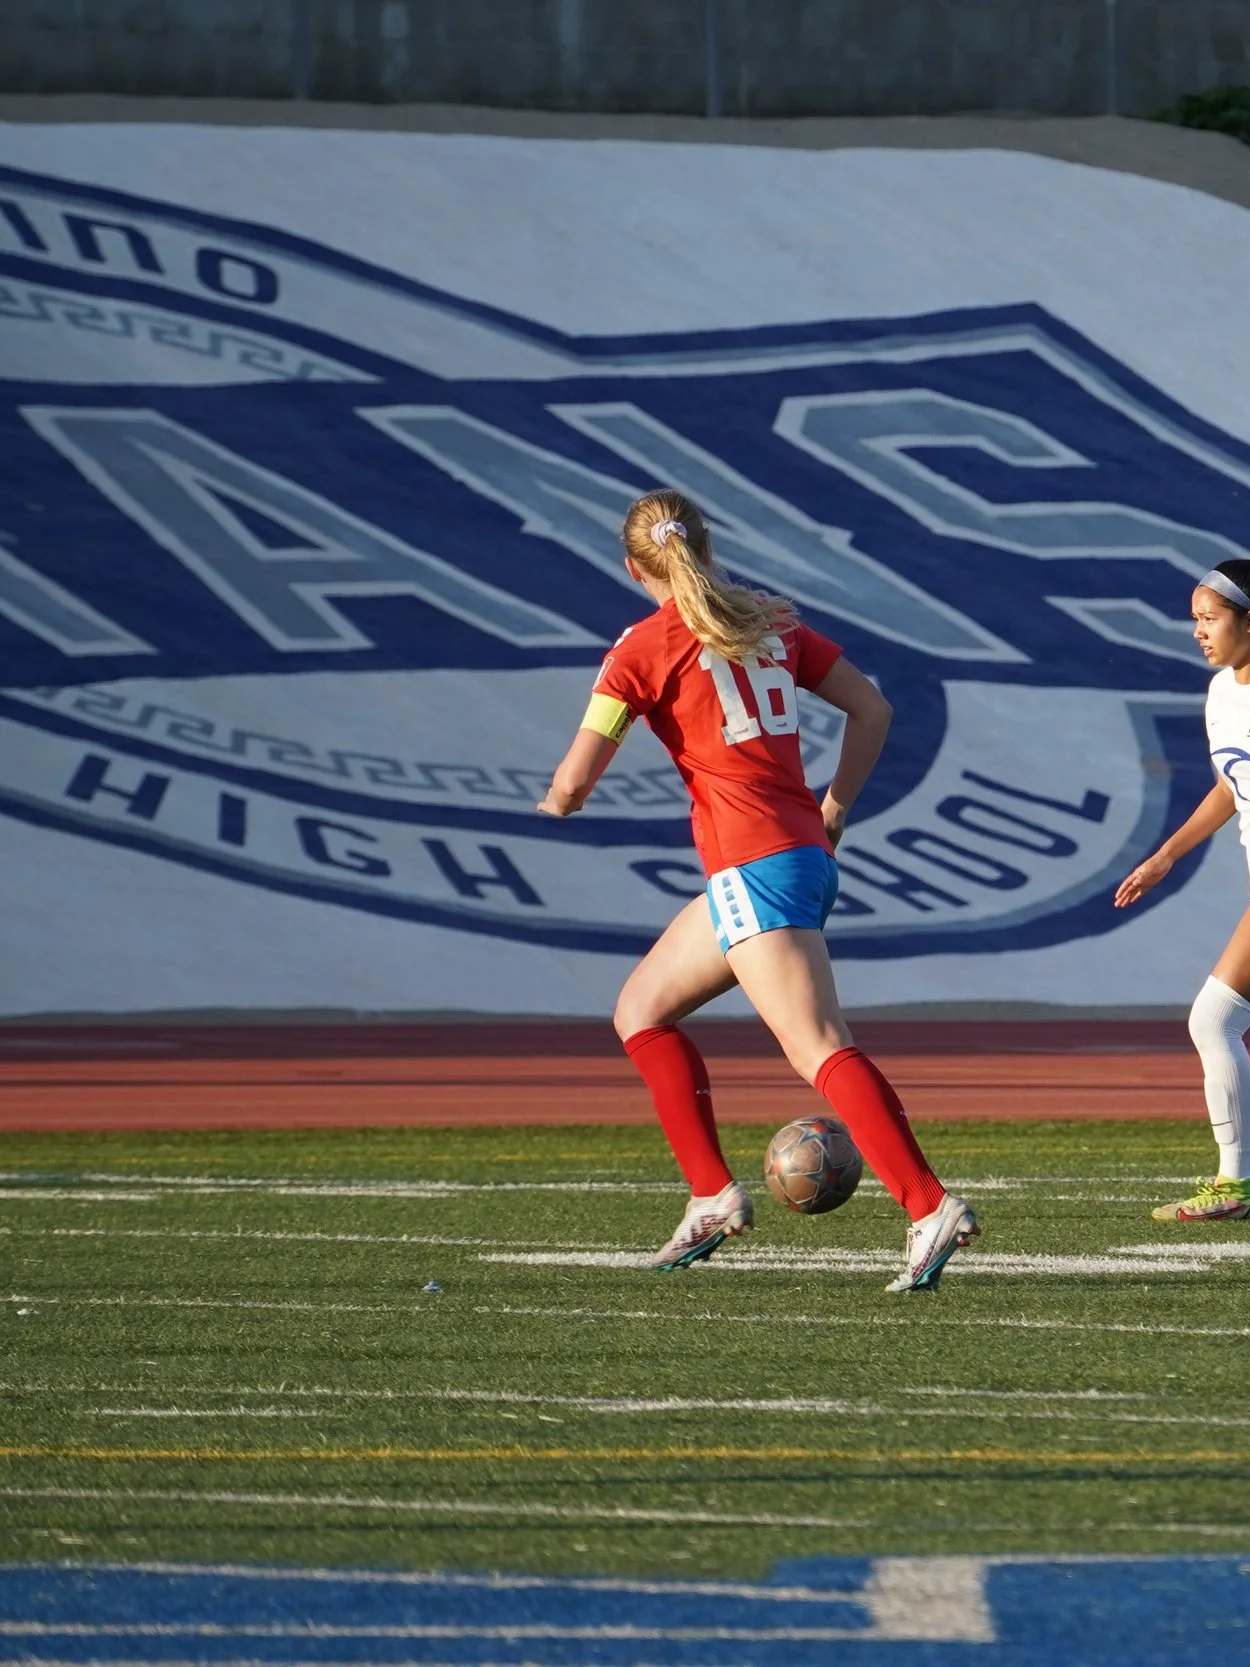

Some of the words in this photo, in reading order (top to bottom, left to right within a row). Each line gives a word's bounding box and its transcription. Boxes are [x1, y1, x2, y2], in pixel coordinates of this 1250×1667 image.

[698, 635, 799, 746] 16
[64, 752, 546, 908] HIGH
[628, 768, 1110, 917] HOOL
